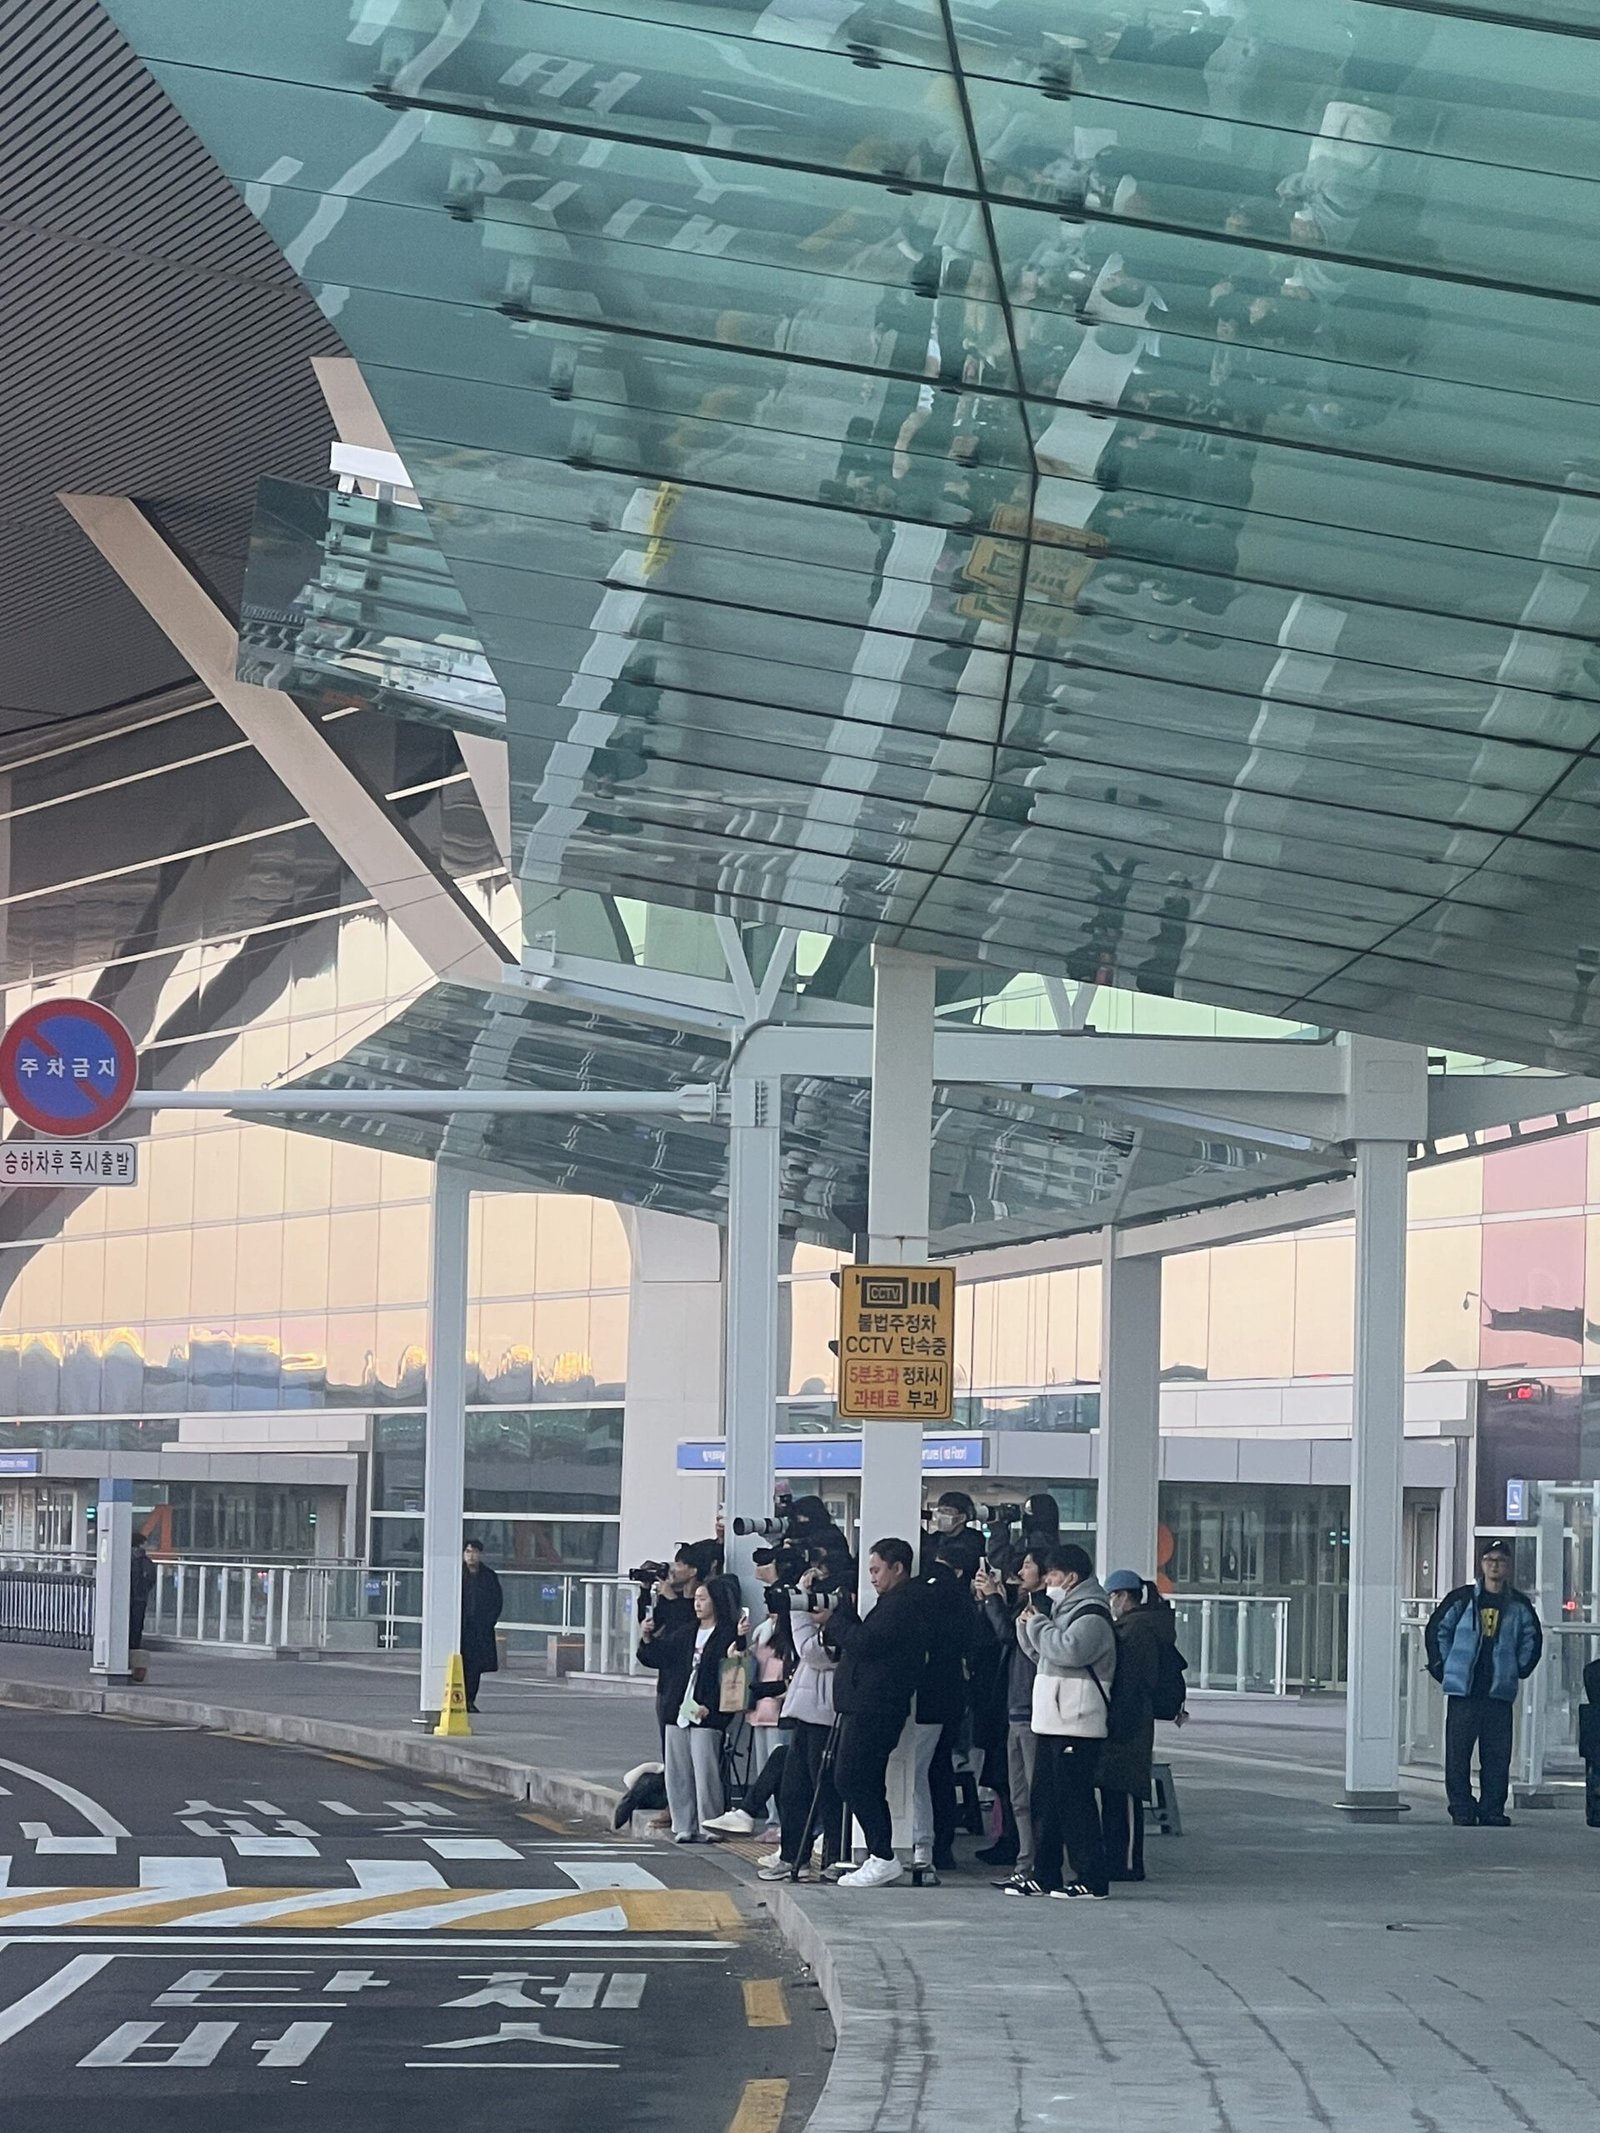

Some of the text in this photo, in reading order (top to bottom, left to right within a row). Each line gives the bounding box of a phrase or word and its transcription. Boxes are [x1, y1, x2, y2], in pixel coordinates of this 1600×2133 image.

[20, 1057, 115, 1079] 주차금지
[5, 1150, 129, 1176] 승하차후 즉시출발
[870, 1287, 899, 1300] CCTV
[858, 1313, 937, 1333] 불법주정차
[846, 1336, 947, 1356] CCTV 단속중
[850, 1365, 943, 1386] 5분초과 정차시
[854, 1388, 939, 1409] 과태료 부과
[150, 1970, 648, 2009] 단체
[75, 2021, 625, 2067] 버스
